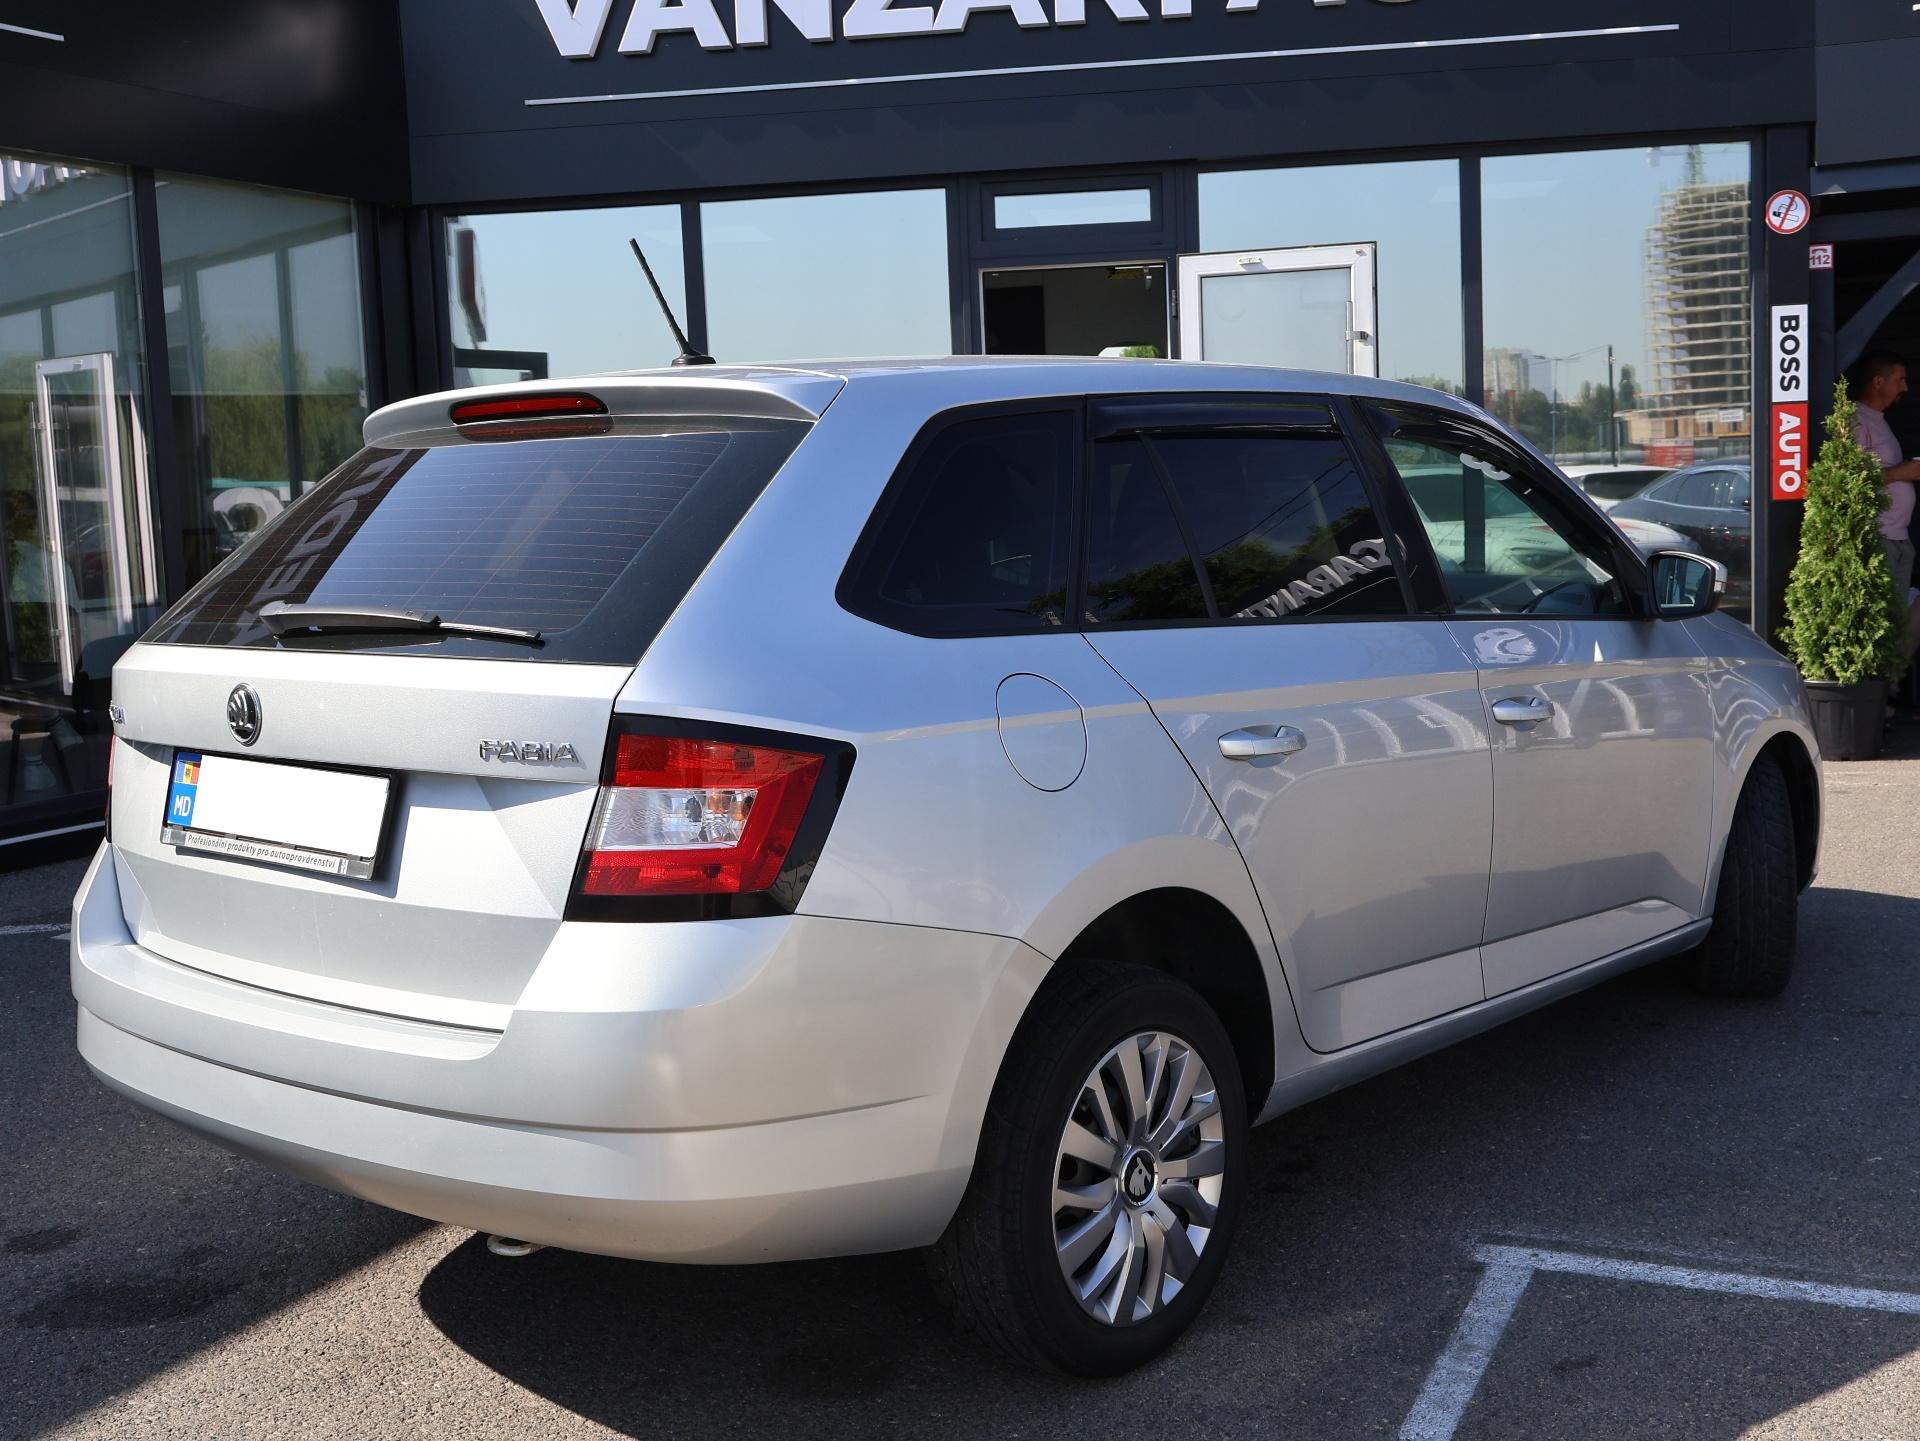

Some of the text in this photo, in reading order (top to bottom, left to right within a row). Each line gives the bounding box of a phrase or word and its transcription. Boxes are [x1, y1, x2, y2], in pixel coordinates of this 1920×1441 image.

[536, 0, 1193, 58] VANZ
[1810, 254, 1831, 266] 112
[1779, 314, 1801, 392] BOSS
[1778, 411, 1801, 493] AUTO
[479, 738, 580, 763] FABIA
[173, 794, 192, 817] MD
[227, 842, 257, 856] produkty
[256, 848, 269, 857] pro
